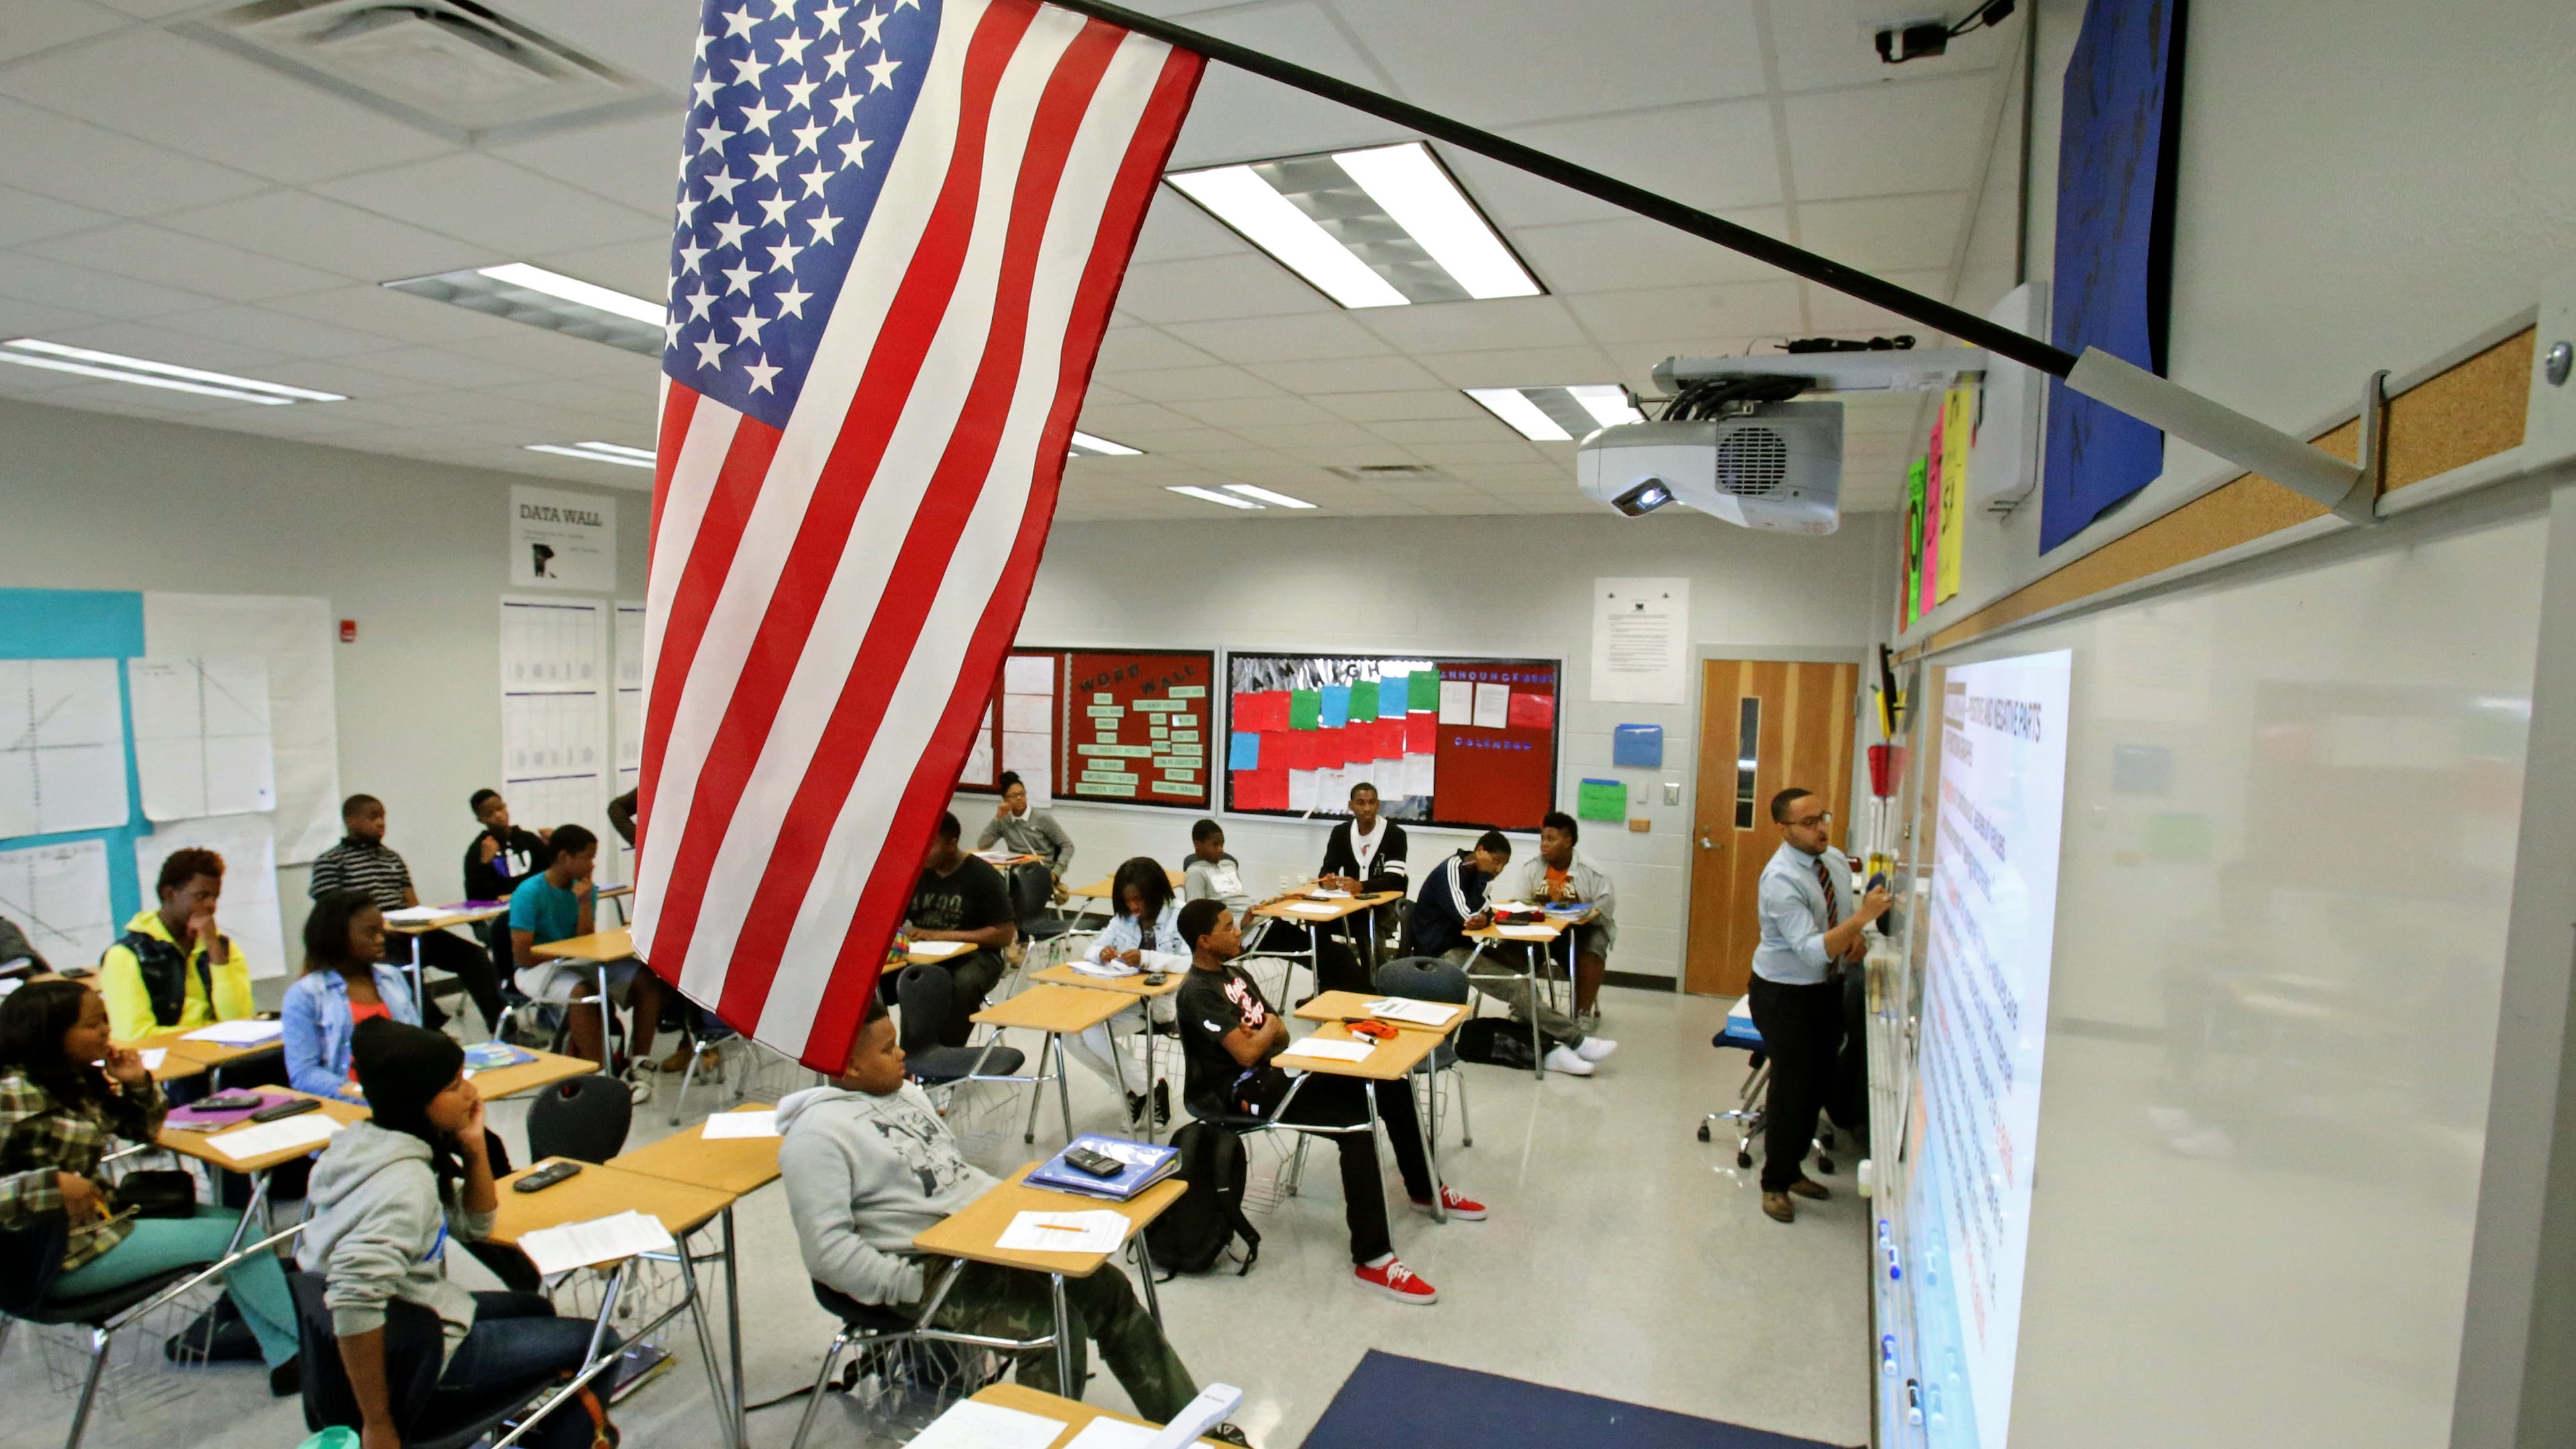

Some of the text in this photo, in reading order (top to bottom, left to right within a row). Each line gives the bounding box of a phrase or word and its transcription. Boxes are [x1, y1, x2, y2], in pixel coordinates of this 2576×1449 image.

[521, 504, 602, 527] DATA WALL
[1078, 663, 1195, 695] WORD WALL
[2019, 701, 2041, 743] PARTS
[1454, 737, 1532, 750] CALENDAR
